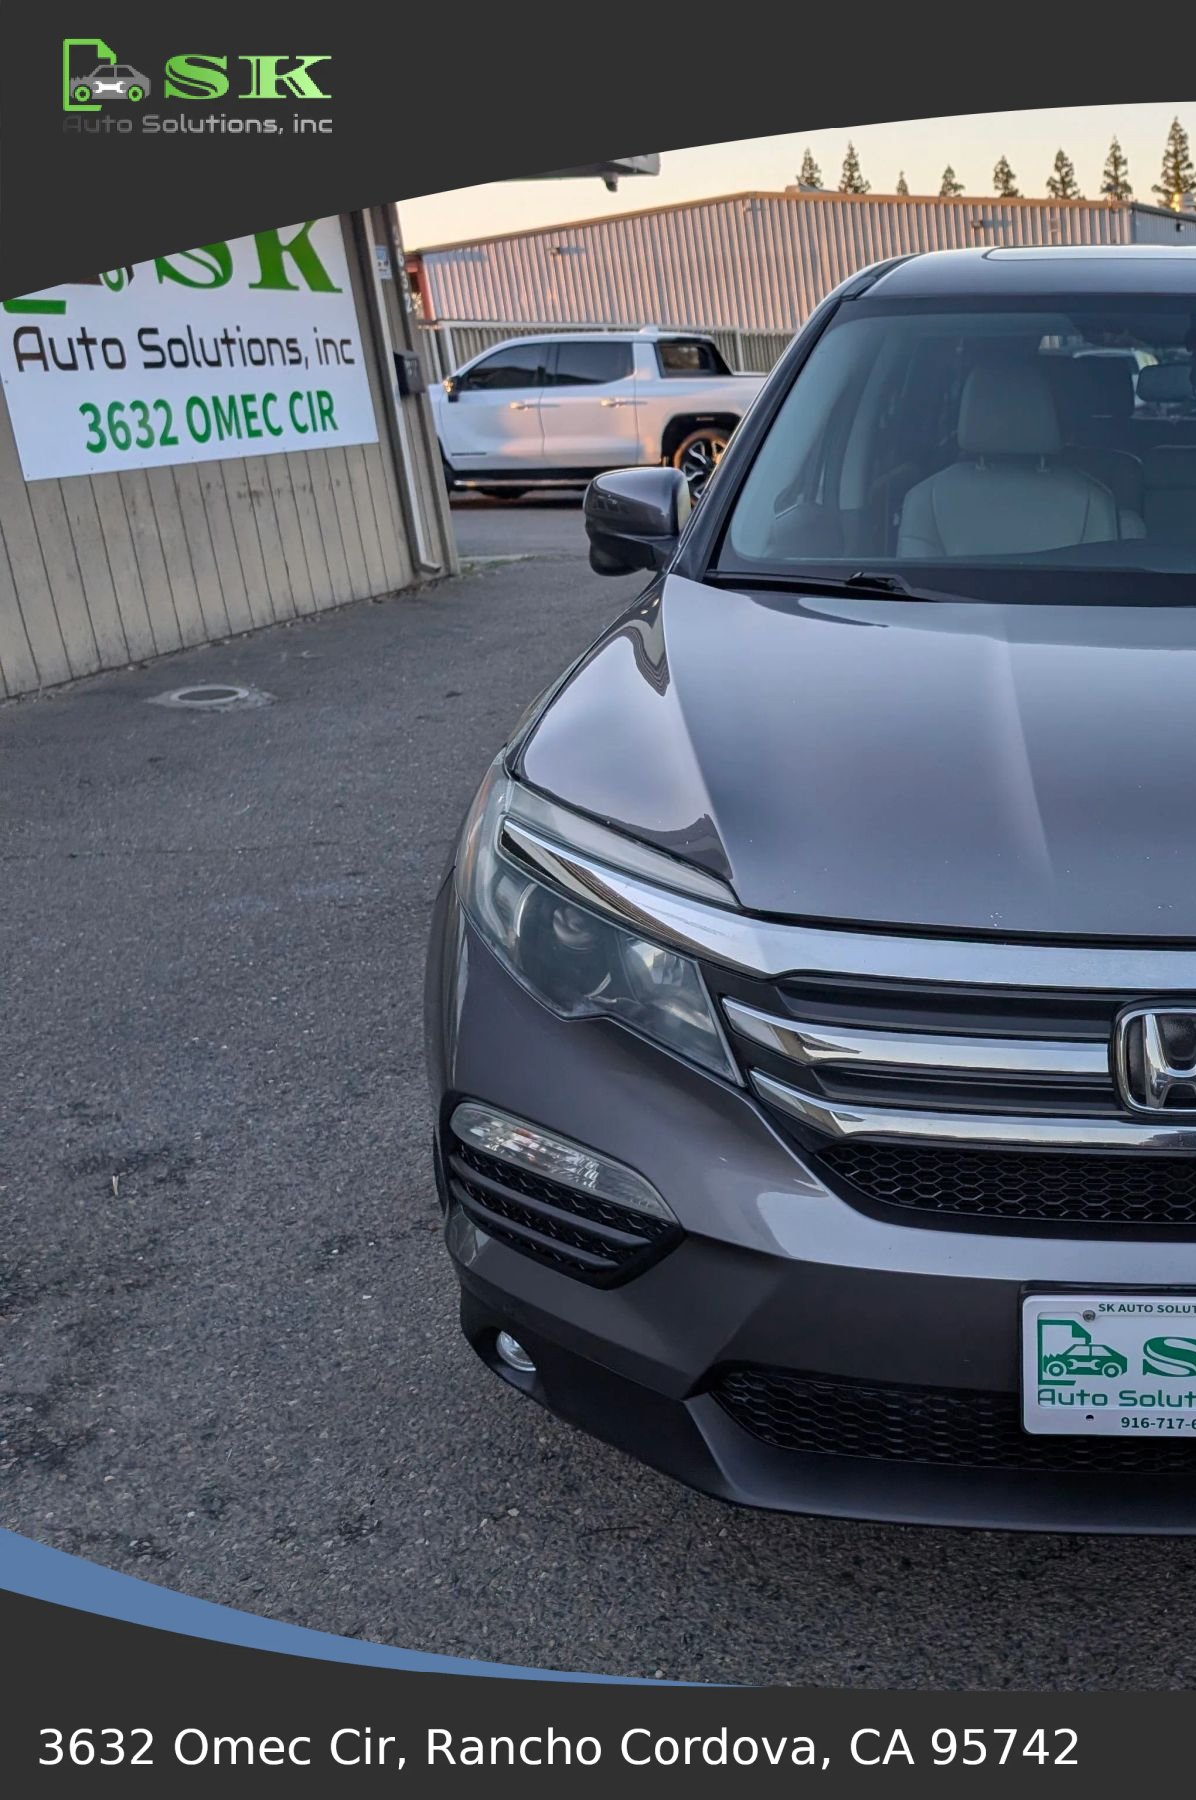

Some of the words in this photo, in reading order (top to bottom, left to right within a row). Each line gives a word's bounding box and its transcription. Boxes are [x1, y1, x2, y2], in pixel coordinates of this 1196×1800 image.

[13, 326, 127, 372] Auto
[137, 325, 309, 370] Solutions,
[313, 327, 355, 365] inc
[79, 398, 179, 453] 3632
[186, 392, 283, 443] OMEC
[289, 390, 338, 434] CIR
[1098, 1303, 1115, 1312] SK
[1118, 1304, 1153, 1313] AUTO
[1038, 1389, 1108, 1407] Auto
